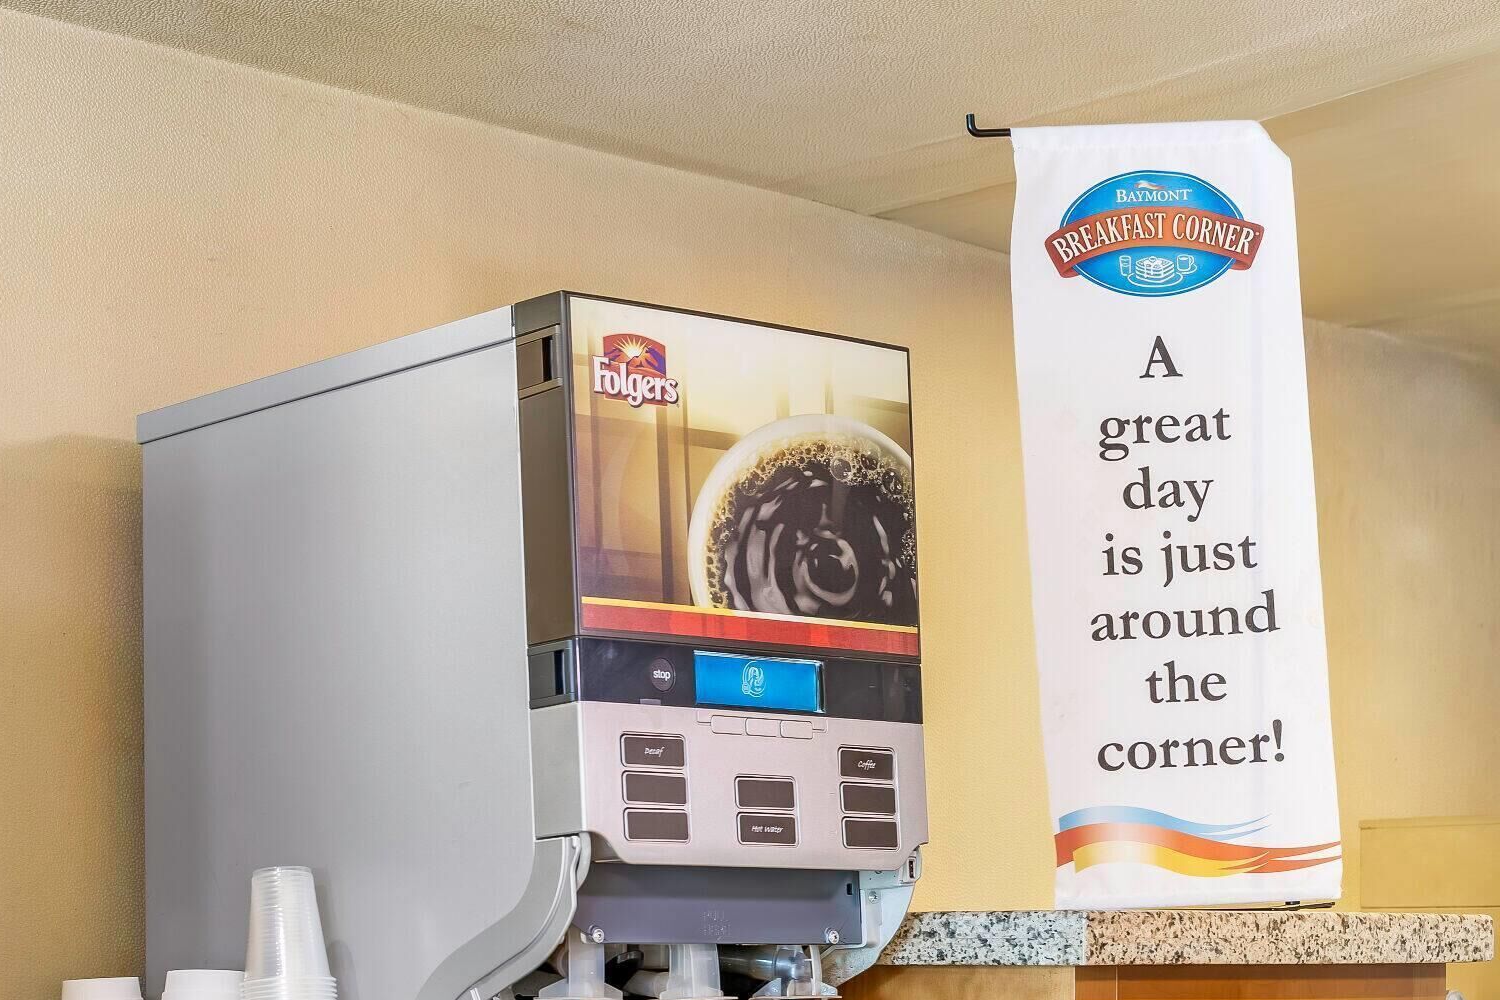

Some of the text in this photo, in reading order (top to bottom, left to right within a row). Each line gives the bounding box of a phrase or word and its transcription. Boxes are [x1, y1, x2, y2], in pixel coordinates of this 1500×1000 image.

[1116, 188, 1188, 203] BAYMONT
[1052, 212, 1254, 263] BREAKFAST CORNER
[592, 355, 678, 408] Folgers
[1139, 335, 1184, 379] A
[1098, 407, 1232, 462] great
[1122, 466, 1214, 523] day
[1101, 530, 1258, 588] is just
[1090, 588, 1281, 642] around
[652, 669, 671, 682] stop
[1145, 660, 1228, 704] the
[857, 759, 876, 771] Coffee
[1097, 719, 1285, 772] corner!
